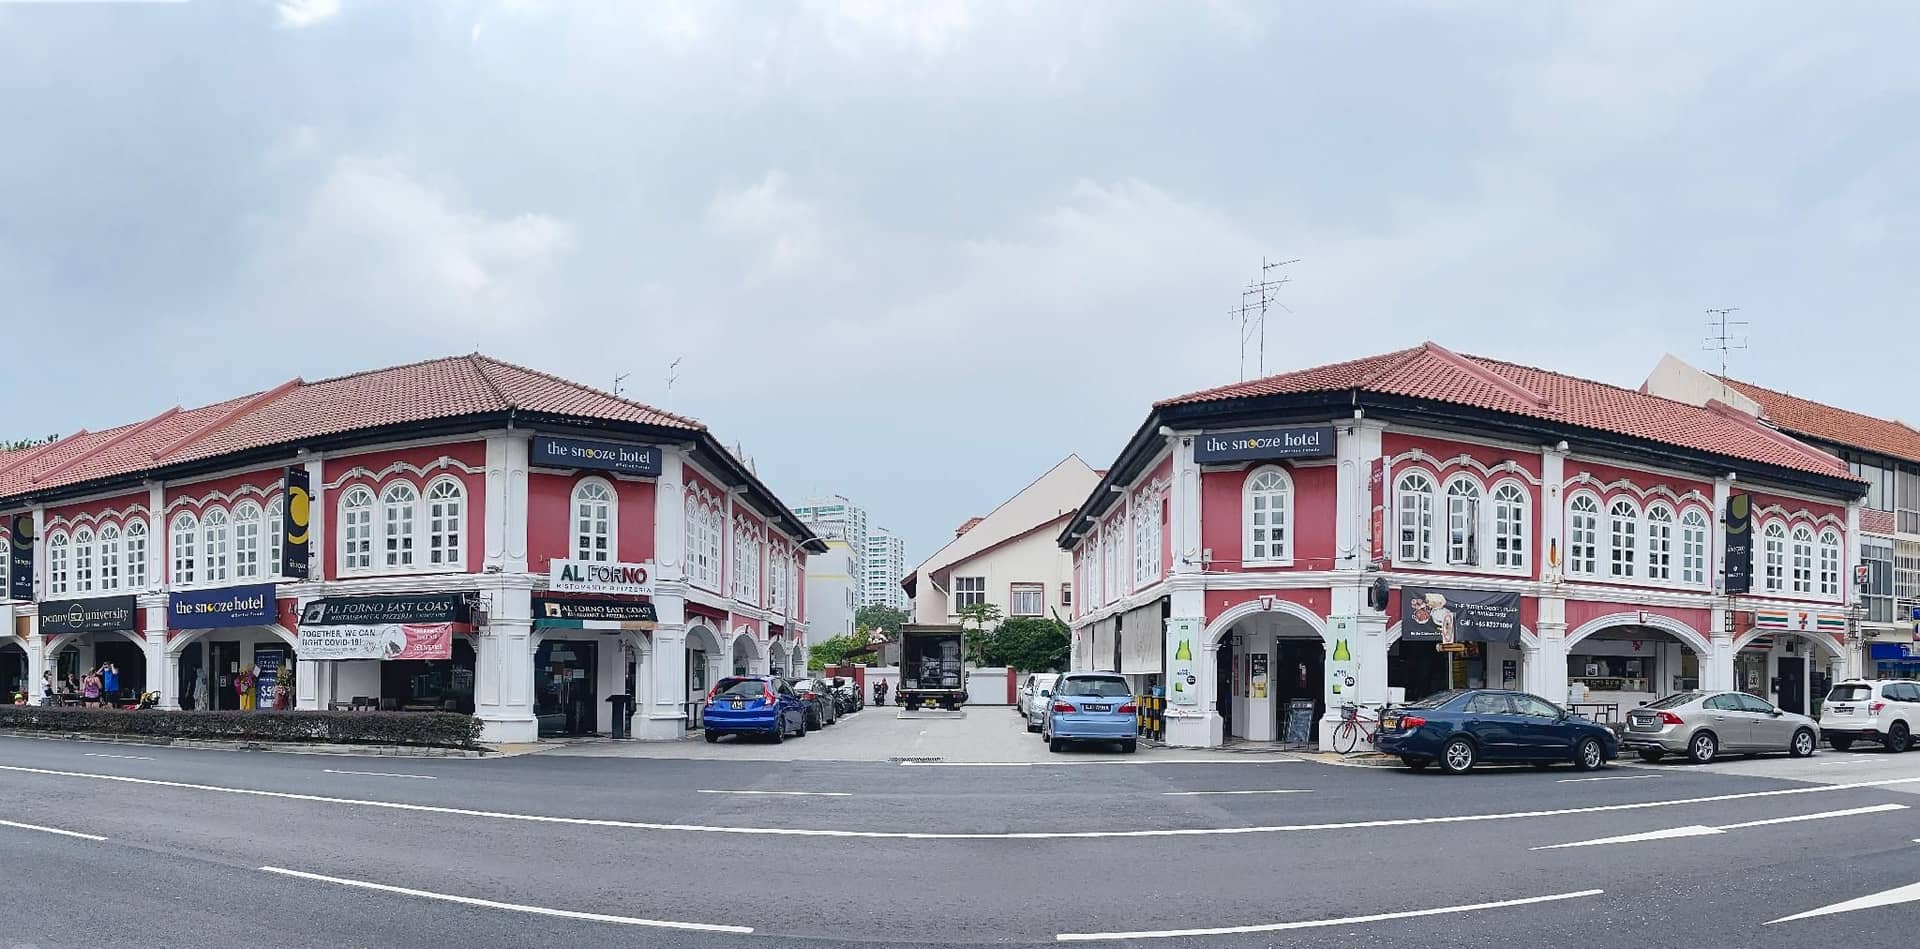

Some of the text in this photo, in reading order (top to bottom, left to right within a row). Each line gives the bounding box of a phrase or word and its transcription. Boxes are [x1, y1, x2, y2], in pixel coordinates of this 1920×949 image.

[1207, 431, 1320, 452] the snooze hotel
[548, 441, 650, 464] the snooze hotel
[561, 564, 648, 584] AL FORNO
[176, 594, 264, 614] the snooze hotel
[326, 605, 340, 614] AL
[342, 603, 384, 613] FORNO
[387, 602, 415, 612] EAST
[42, 612, 70, 627] penny
[85, 608, 129, 622] university
[345, 629, 357, 637] WE
[359, 629, 376, 637] CAN
